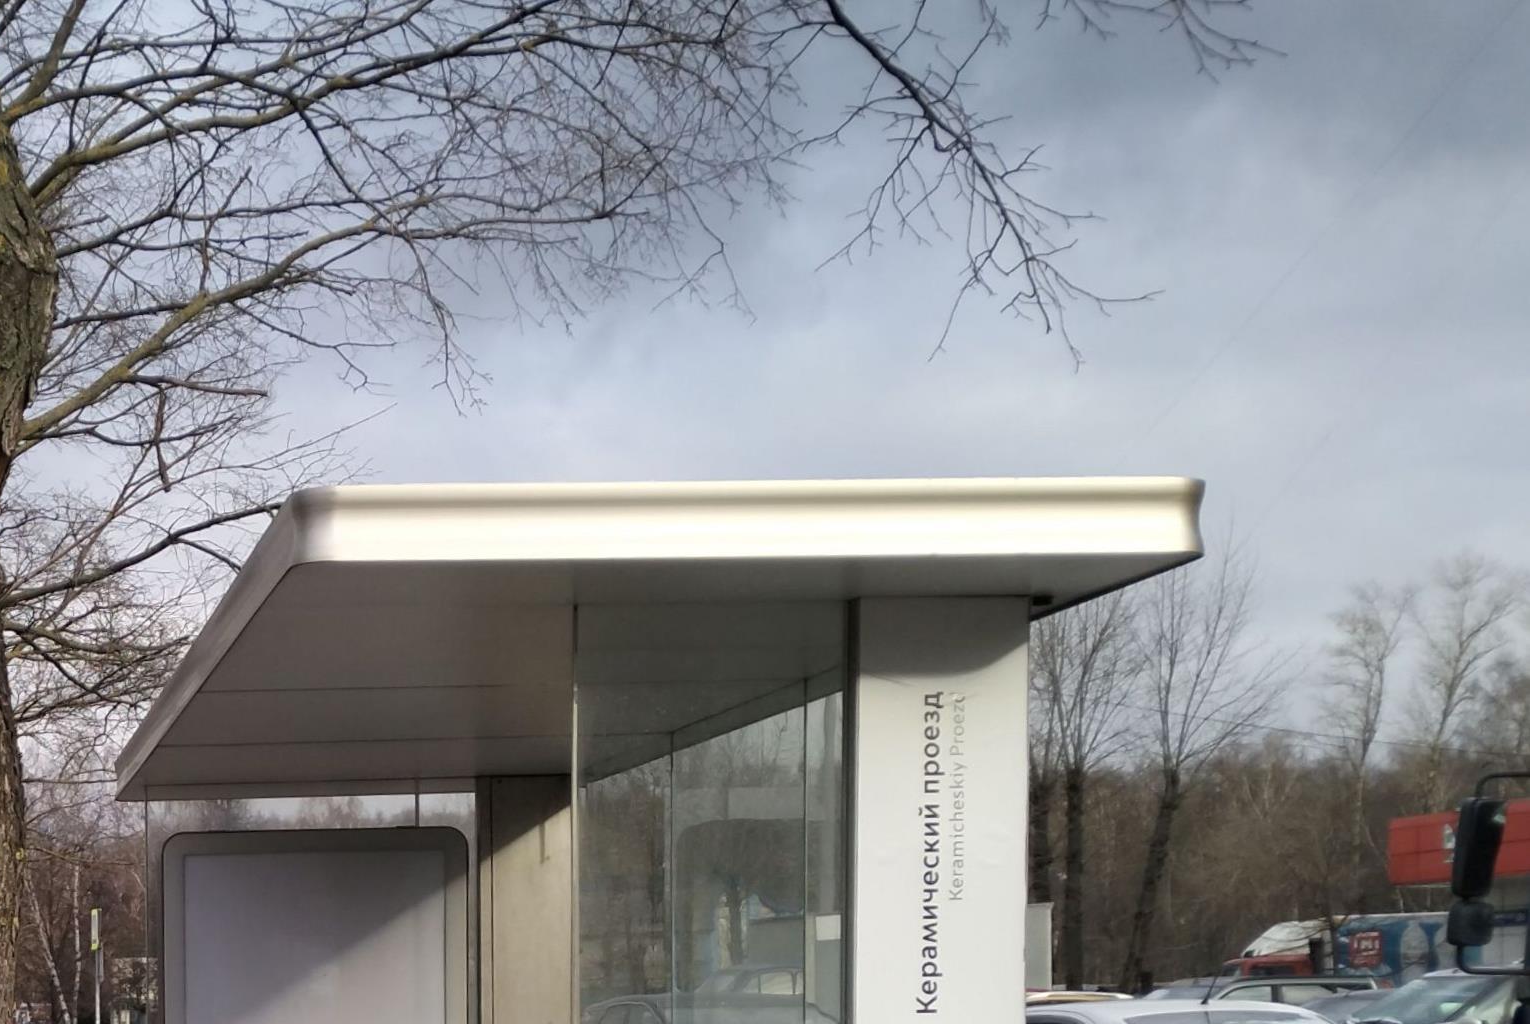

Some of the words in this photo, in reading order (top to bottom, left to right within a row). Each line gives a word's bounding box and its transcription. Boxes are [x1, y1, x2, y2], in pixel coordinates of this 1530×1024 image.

[924, 691, 945, 794] проезд
[949, 761, 968, 901] Keramicheskiy
[915, 803, 944, 1015] Керамический
